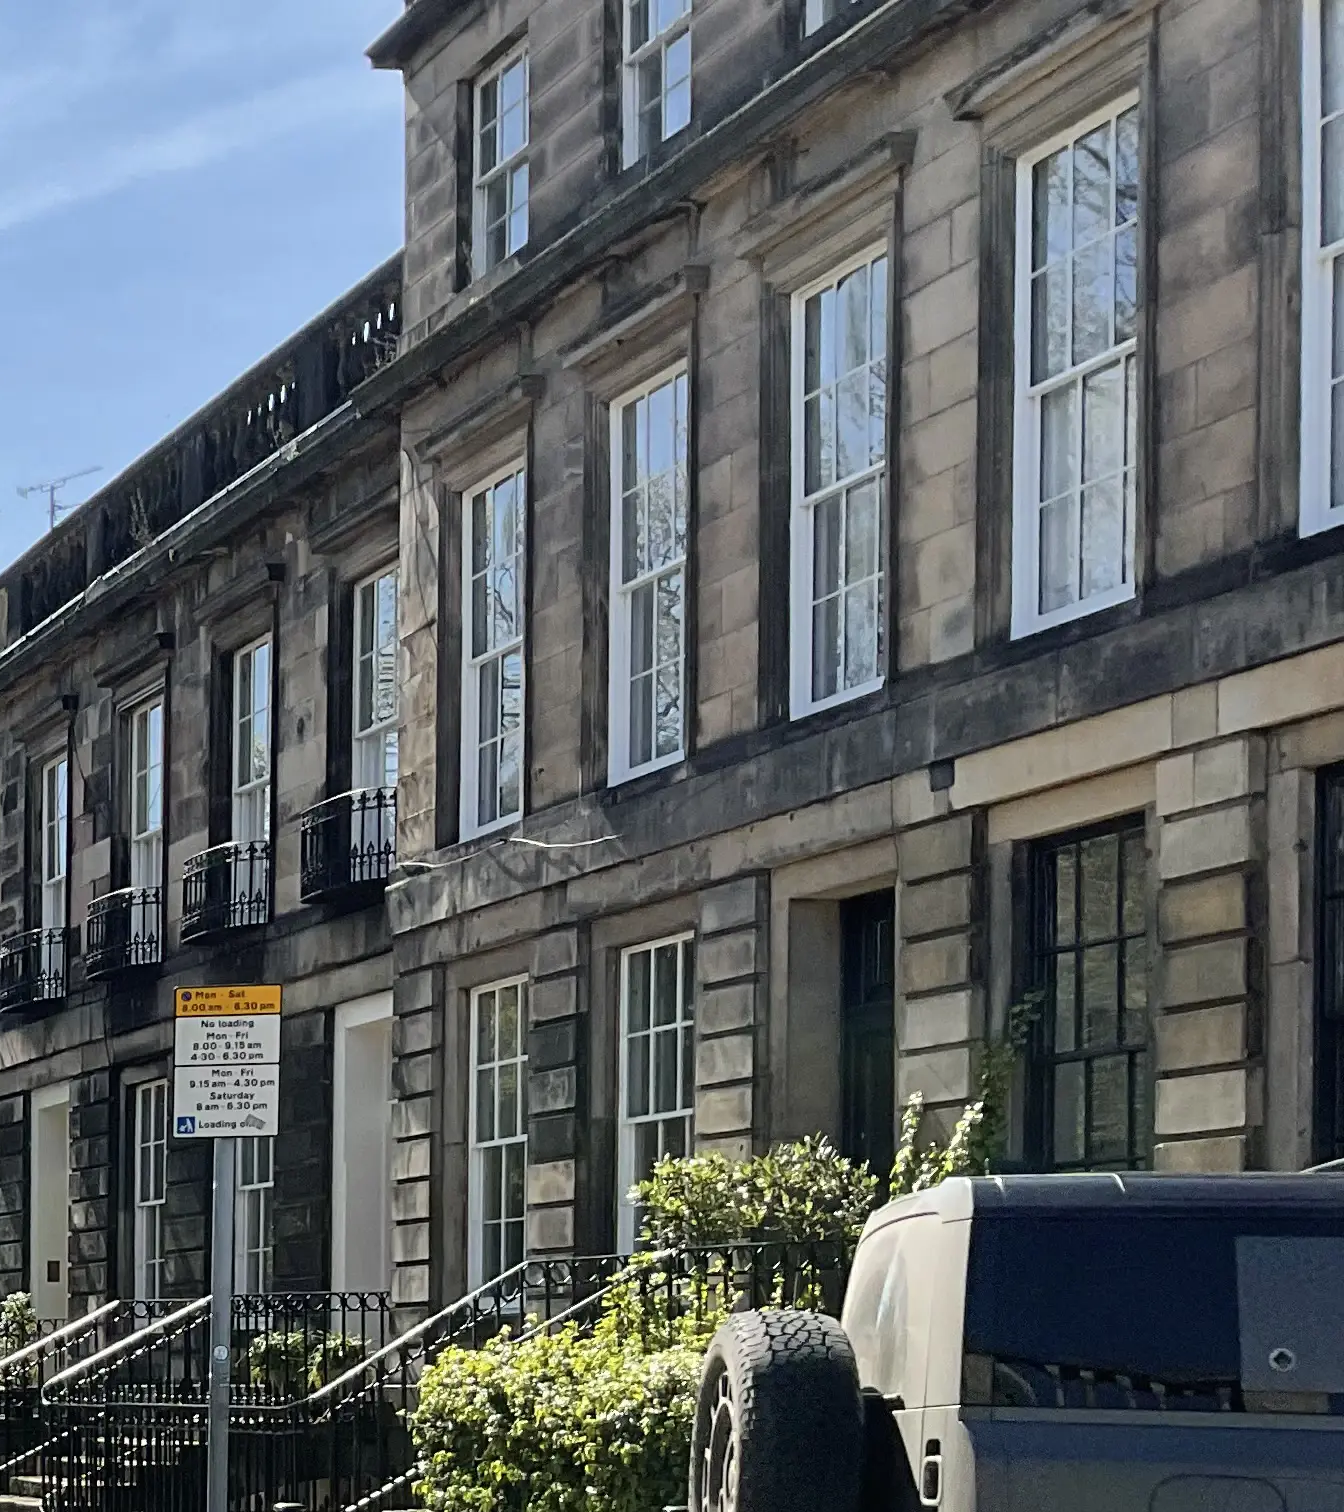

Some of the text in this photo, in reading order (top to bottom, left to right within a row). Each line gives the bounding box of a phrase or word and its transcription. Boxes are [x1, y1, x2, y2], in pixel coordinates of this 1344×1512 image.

[195, 991, 216, 999] Mon
[228, 990, 245, 998] Sat
[182, 1004, 205, 1012] 8.00
[234, 1002, 257, 1010] 6.30
[201, 1020, 254, 1028] No loading
[206, 1032, 227, 1040] Mon
[223, 1052, 246, 1060] 6.30
[212, 1069, 232, 1077] Mon
[240, 1068, 253, 1076] Fri
[190, 1080, 209, 1088] 9.15
[234, 1079, 257, 1087] 4.30
[209, 1092, 255, 1100] Saturday
[227, 1102, 250, 1110] 6.30
[253, 1103, 267, 1111] pm
[199, 1120, 236, 1129] Loading
